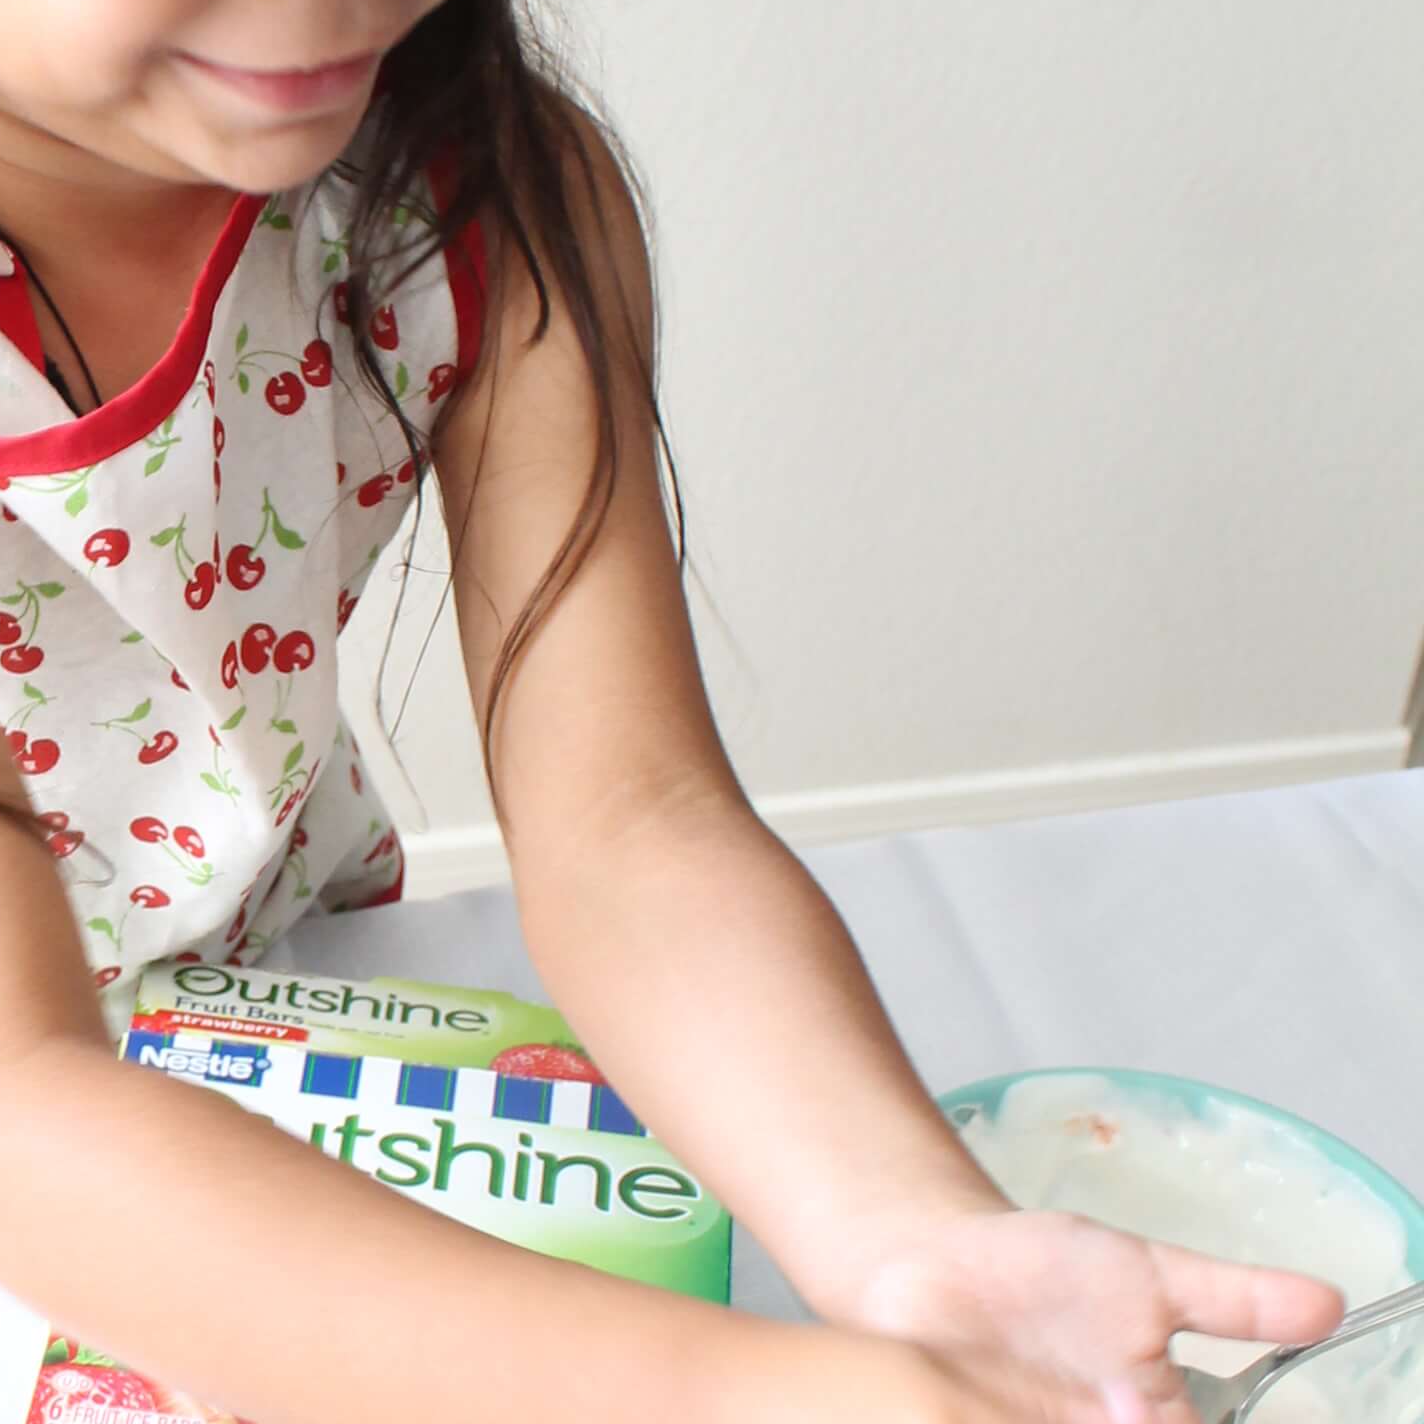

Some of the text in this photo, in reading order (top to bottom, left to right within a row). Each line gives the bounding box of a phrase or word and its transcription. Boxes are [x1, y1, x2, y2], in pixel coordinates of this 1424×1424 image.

[173, 965, 489, 1034] Outshine
[175, 995, 305, 1026] Fruit Bars
[169, 1011, 289, 1038] strawberry
